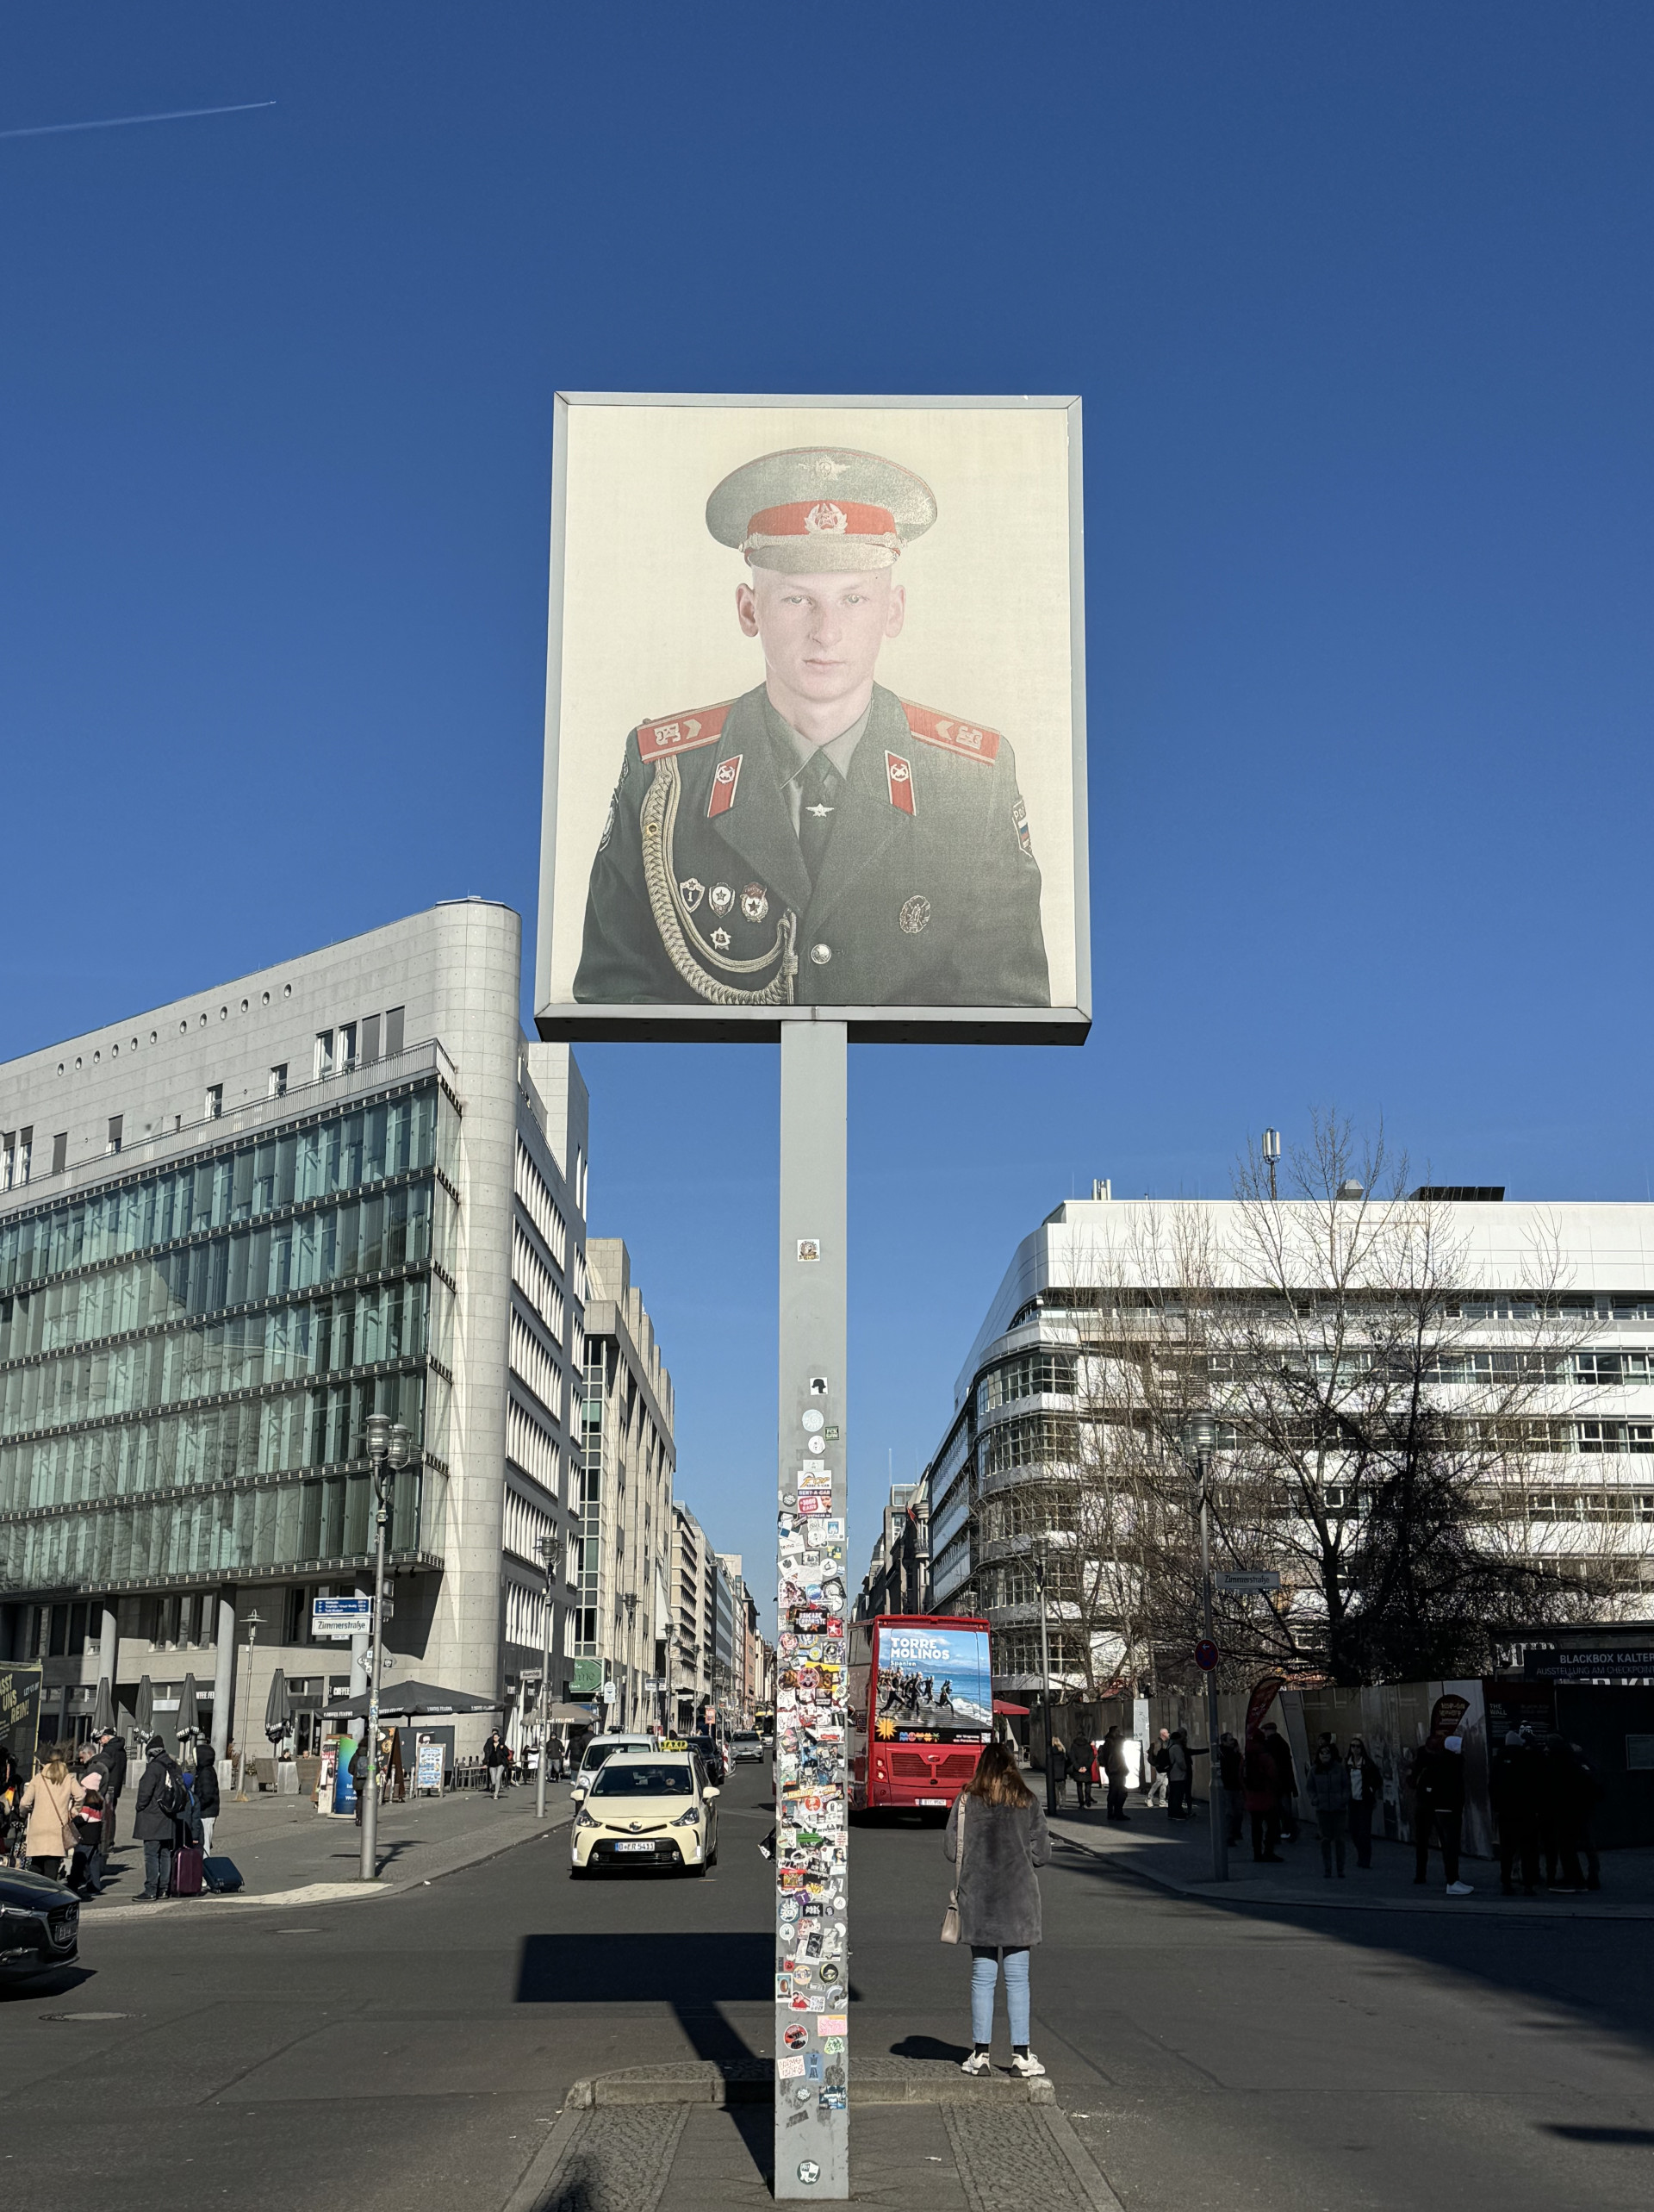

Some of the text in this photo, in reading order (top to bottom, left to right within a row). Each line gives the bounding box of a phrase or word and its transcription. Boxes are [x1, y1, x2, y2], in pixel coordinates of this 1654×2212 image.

[1224, 1574, 1270, 1585] Zimmerstraße
[318, 1621, 365, 1630] Zimmerstraße
[891, 1637, 937, 1649] TORRE
[891, 1647, 950, 1660] MOLINOS
[1560, 1654, 1614, 1664] BLACKBOX
[1536, 1667, 1589, 1675] AUSSTELLUNG
[3, 1689, 17, 1711] UNS
[10, 1699, 30, 1724] REIN!
[797, 1892, 806, 1903] T
